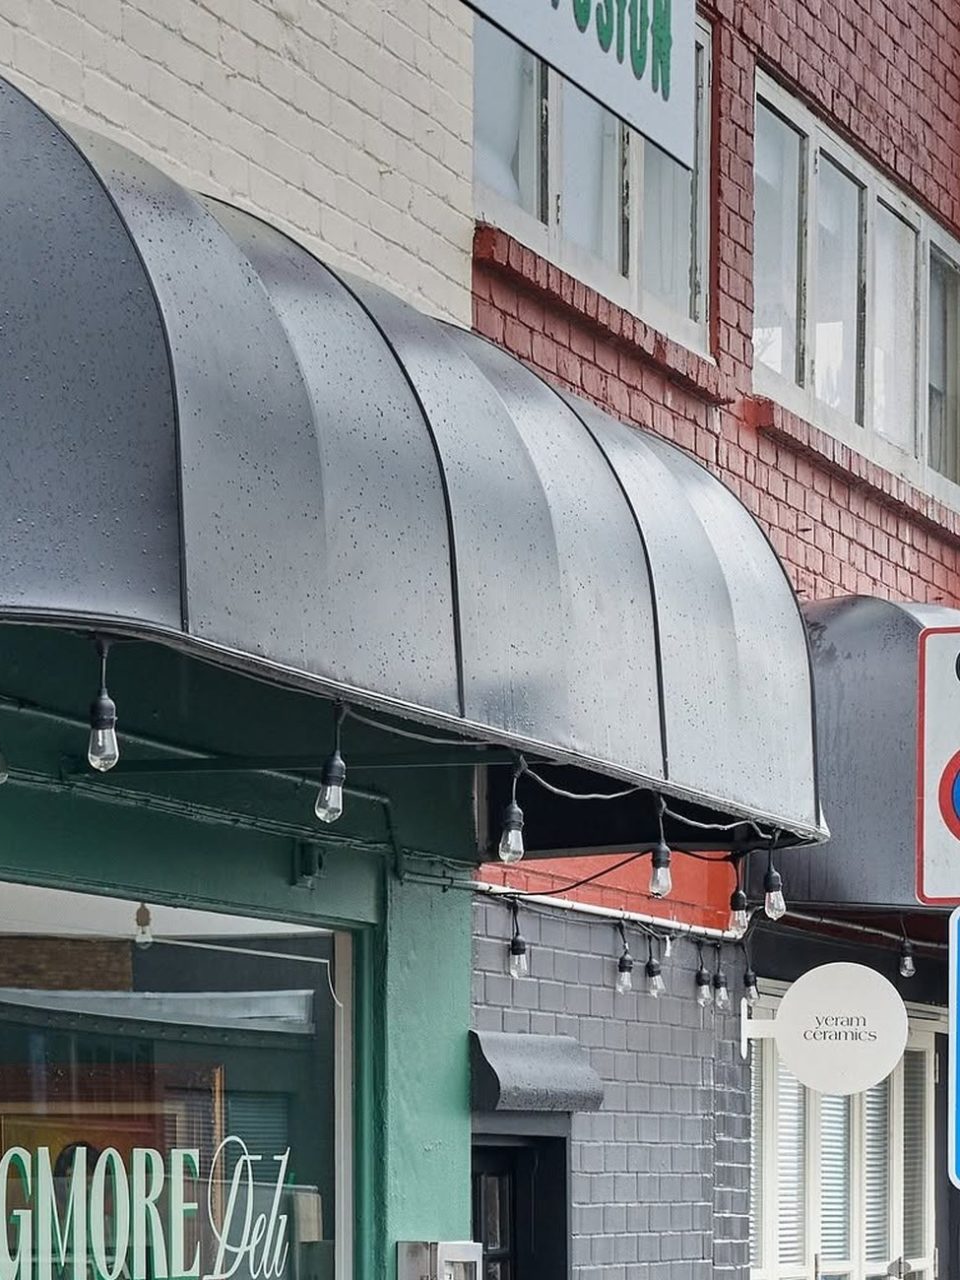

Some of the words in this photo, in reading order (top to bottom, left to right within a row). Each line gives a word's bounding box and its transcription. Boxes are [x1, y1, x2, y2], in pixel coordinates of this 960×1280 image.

[815, 1015, 867, 1029] yeram
[803, 1028, 878, 1041] ceramics
[202, 1135, 291, 1280] Deli
